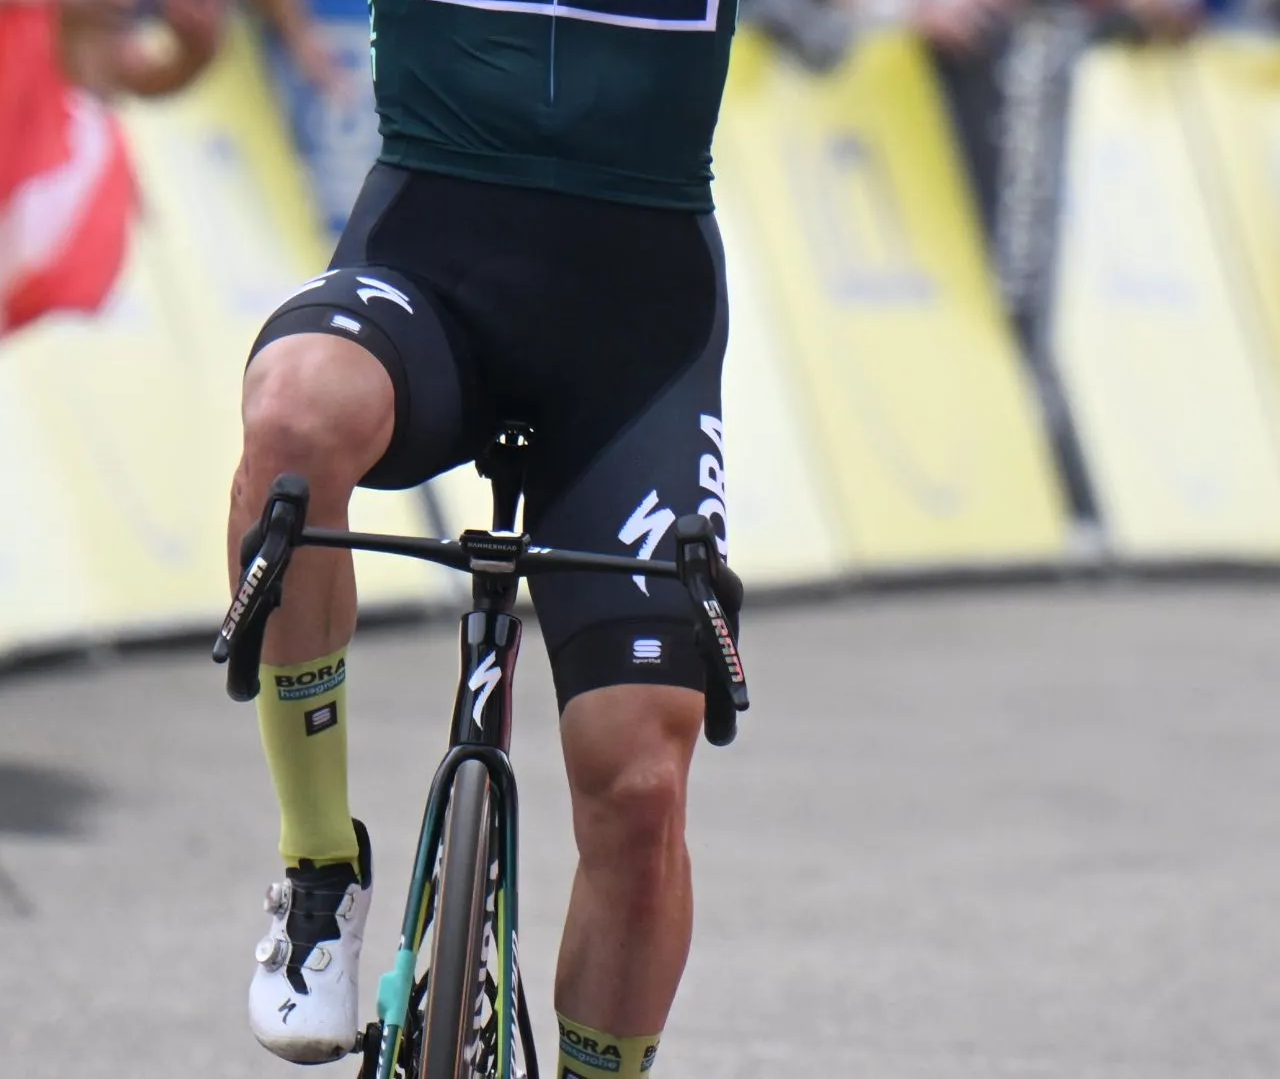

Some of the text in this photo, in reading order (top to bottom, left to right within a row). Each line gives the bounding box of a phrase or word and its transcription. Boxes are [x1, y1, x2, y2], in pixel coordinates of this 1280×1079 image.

[467, 542, 517, 551] HAMMERHEAD
[221, 556, 268, 641] SRAM
[703, 599, 744, 683] SRAM
[275, 657, 346, 688] BORA
